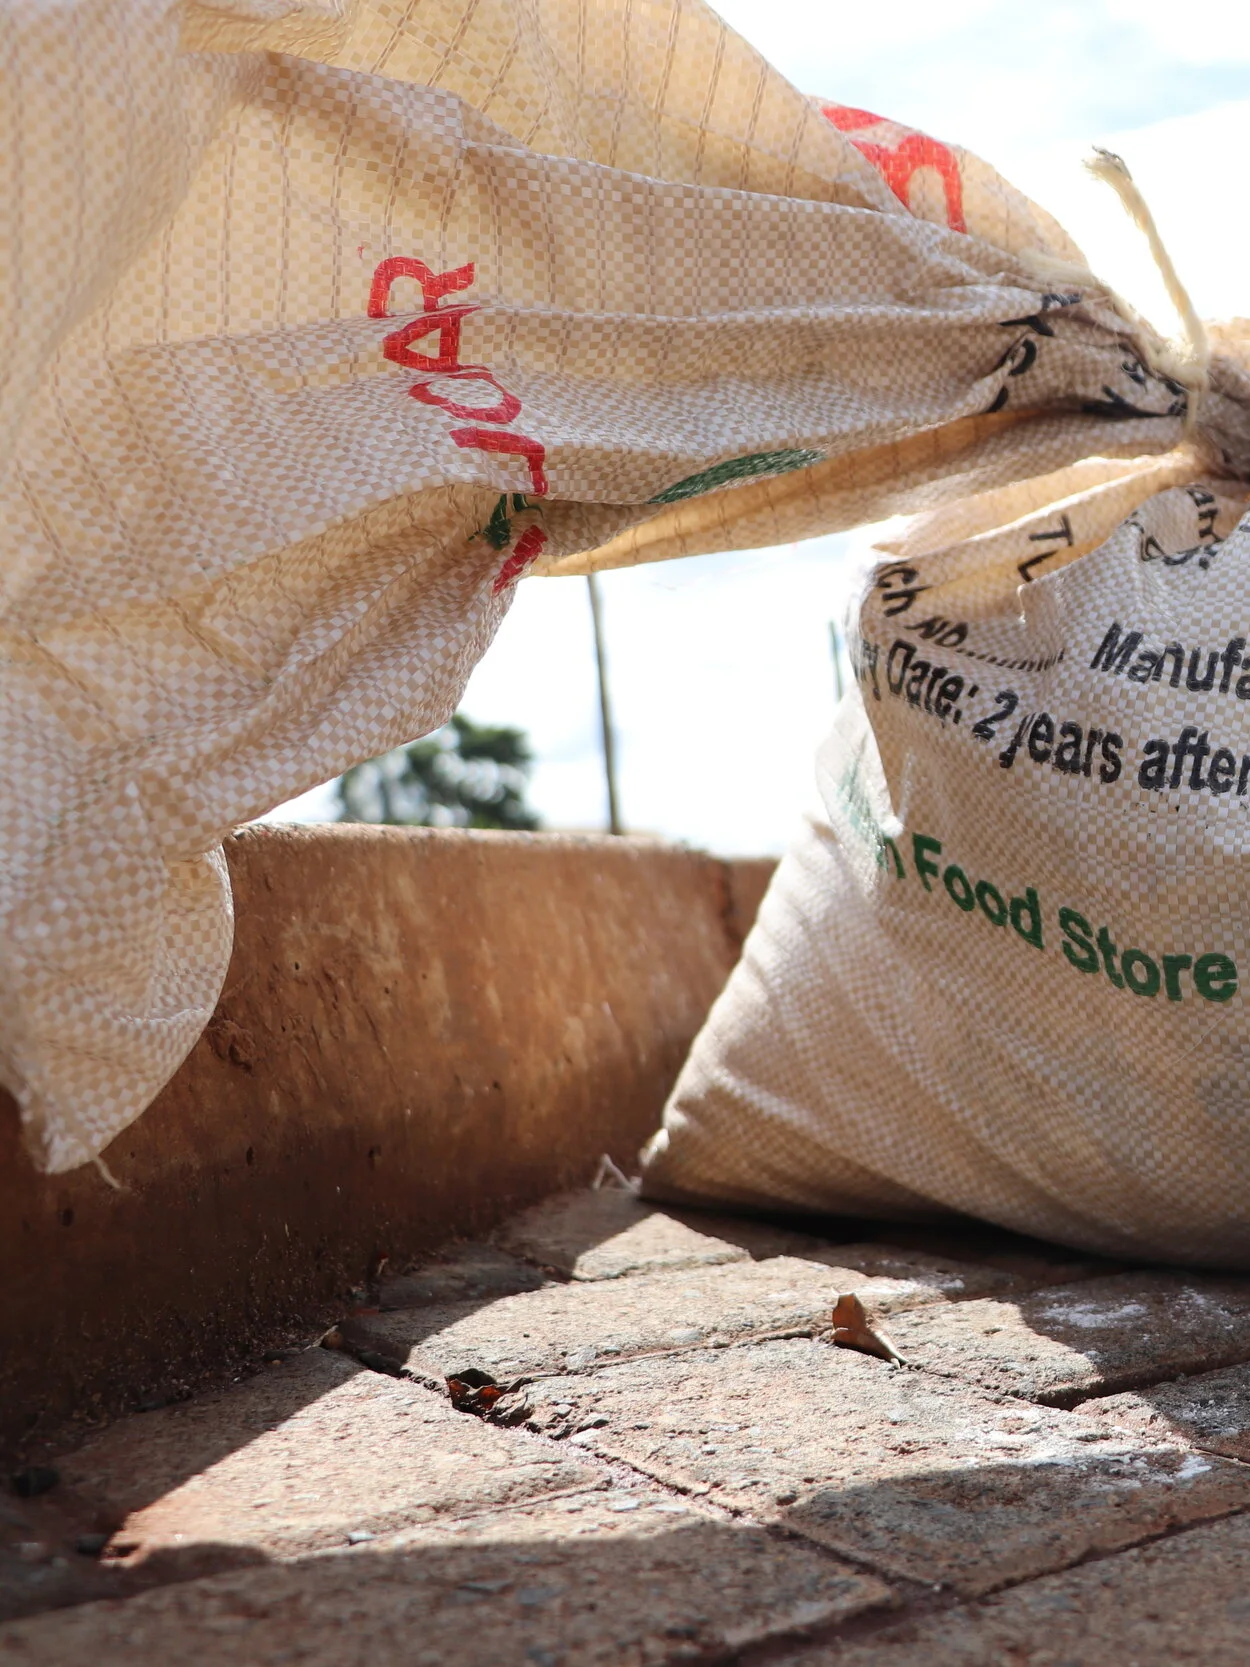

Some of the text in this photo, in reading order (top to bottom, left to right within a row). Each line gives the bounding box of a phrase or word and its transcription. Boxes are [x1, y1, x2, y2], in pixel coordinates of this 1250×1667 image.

[971, 690, 1019, 743] 2
[911, 832, 1045, 950] Food
[1058, 906, 1239, 1003] Store
